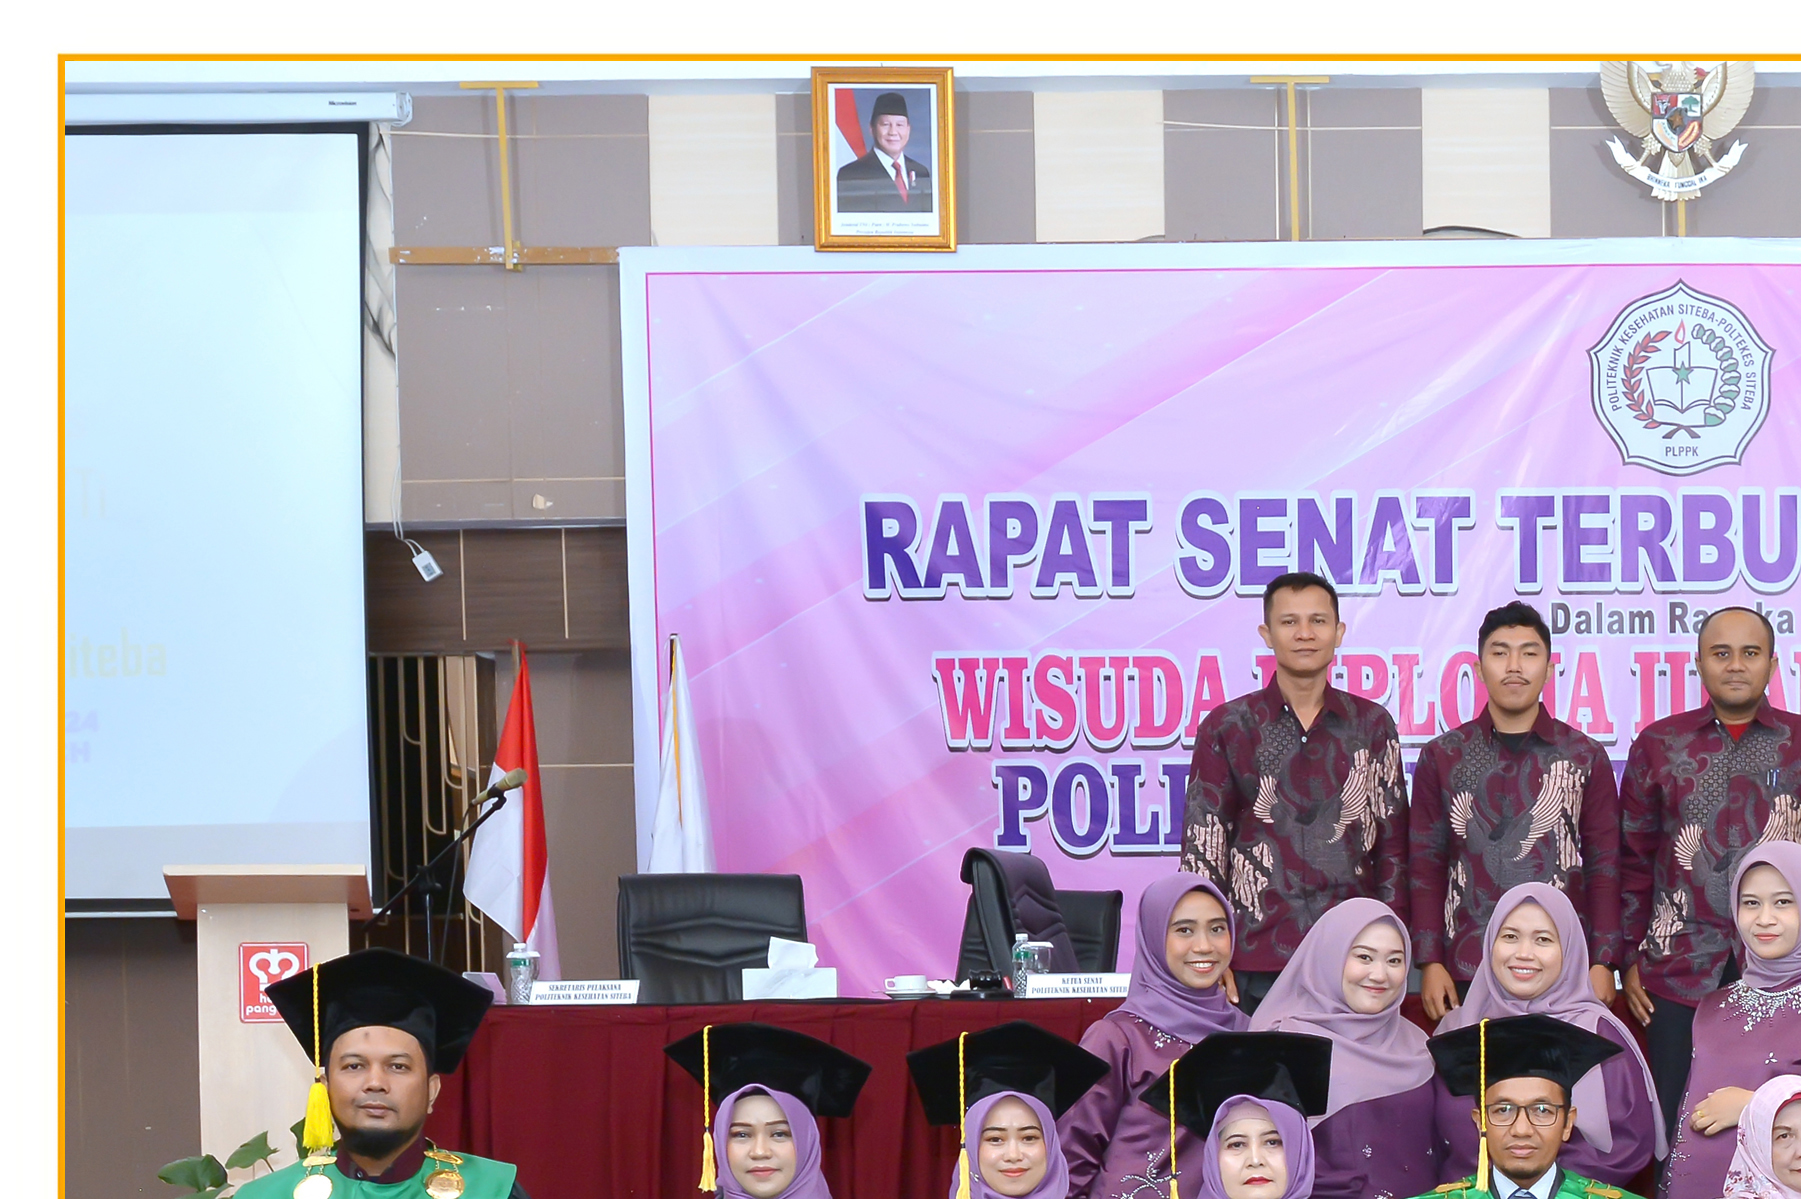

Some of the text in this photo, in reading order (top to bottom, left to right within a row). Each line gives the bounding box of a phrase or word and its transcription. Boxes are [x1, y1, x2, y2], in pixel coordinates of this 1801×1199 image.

[1606, 344, 1625, 412] POLITEKNIK
[1618, 303, 1675, 345] KESEHATAN
[1739, 371, 1757, 412] SITEBA
[1665, 445, 1699, 457] PLPPK
[861, 493, 1153, 600] RAPAT
[1174, 491, 1476, 598] SENAT
[1550, 601, 1656, 635] Dalam
[69, 626, 167, 679] iteba
[1061, 977, 1103, 985] KETUA SENAT
[1031, 985, 1128, 995] POLITEKNIK KESEHATAN SITEB
[534, 993, 572, 1001] POLITEKNIK
[610, 992, 632, 1000] SITEBA
[245, 1005, 277, 1016] pang
